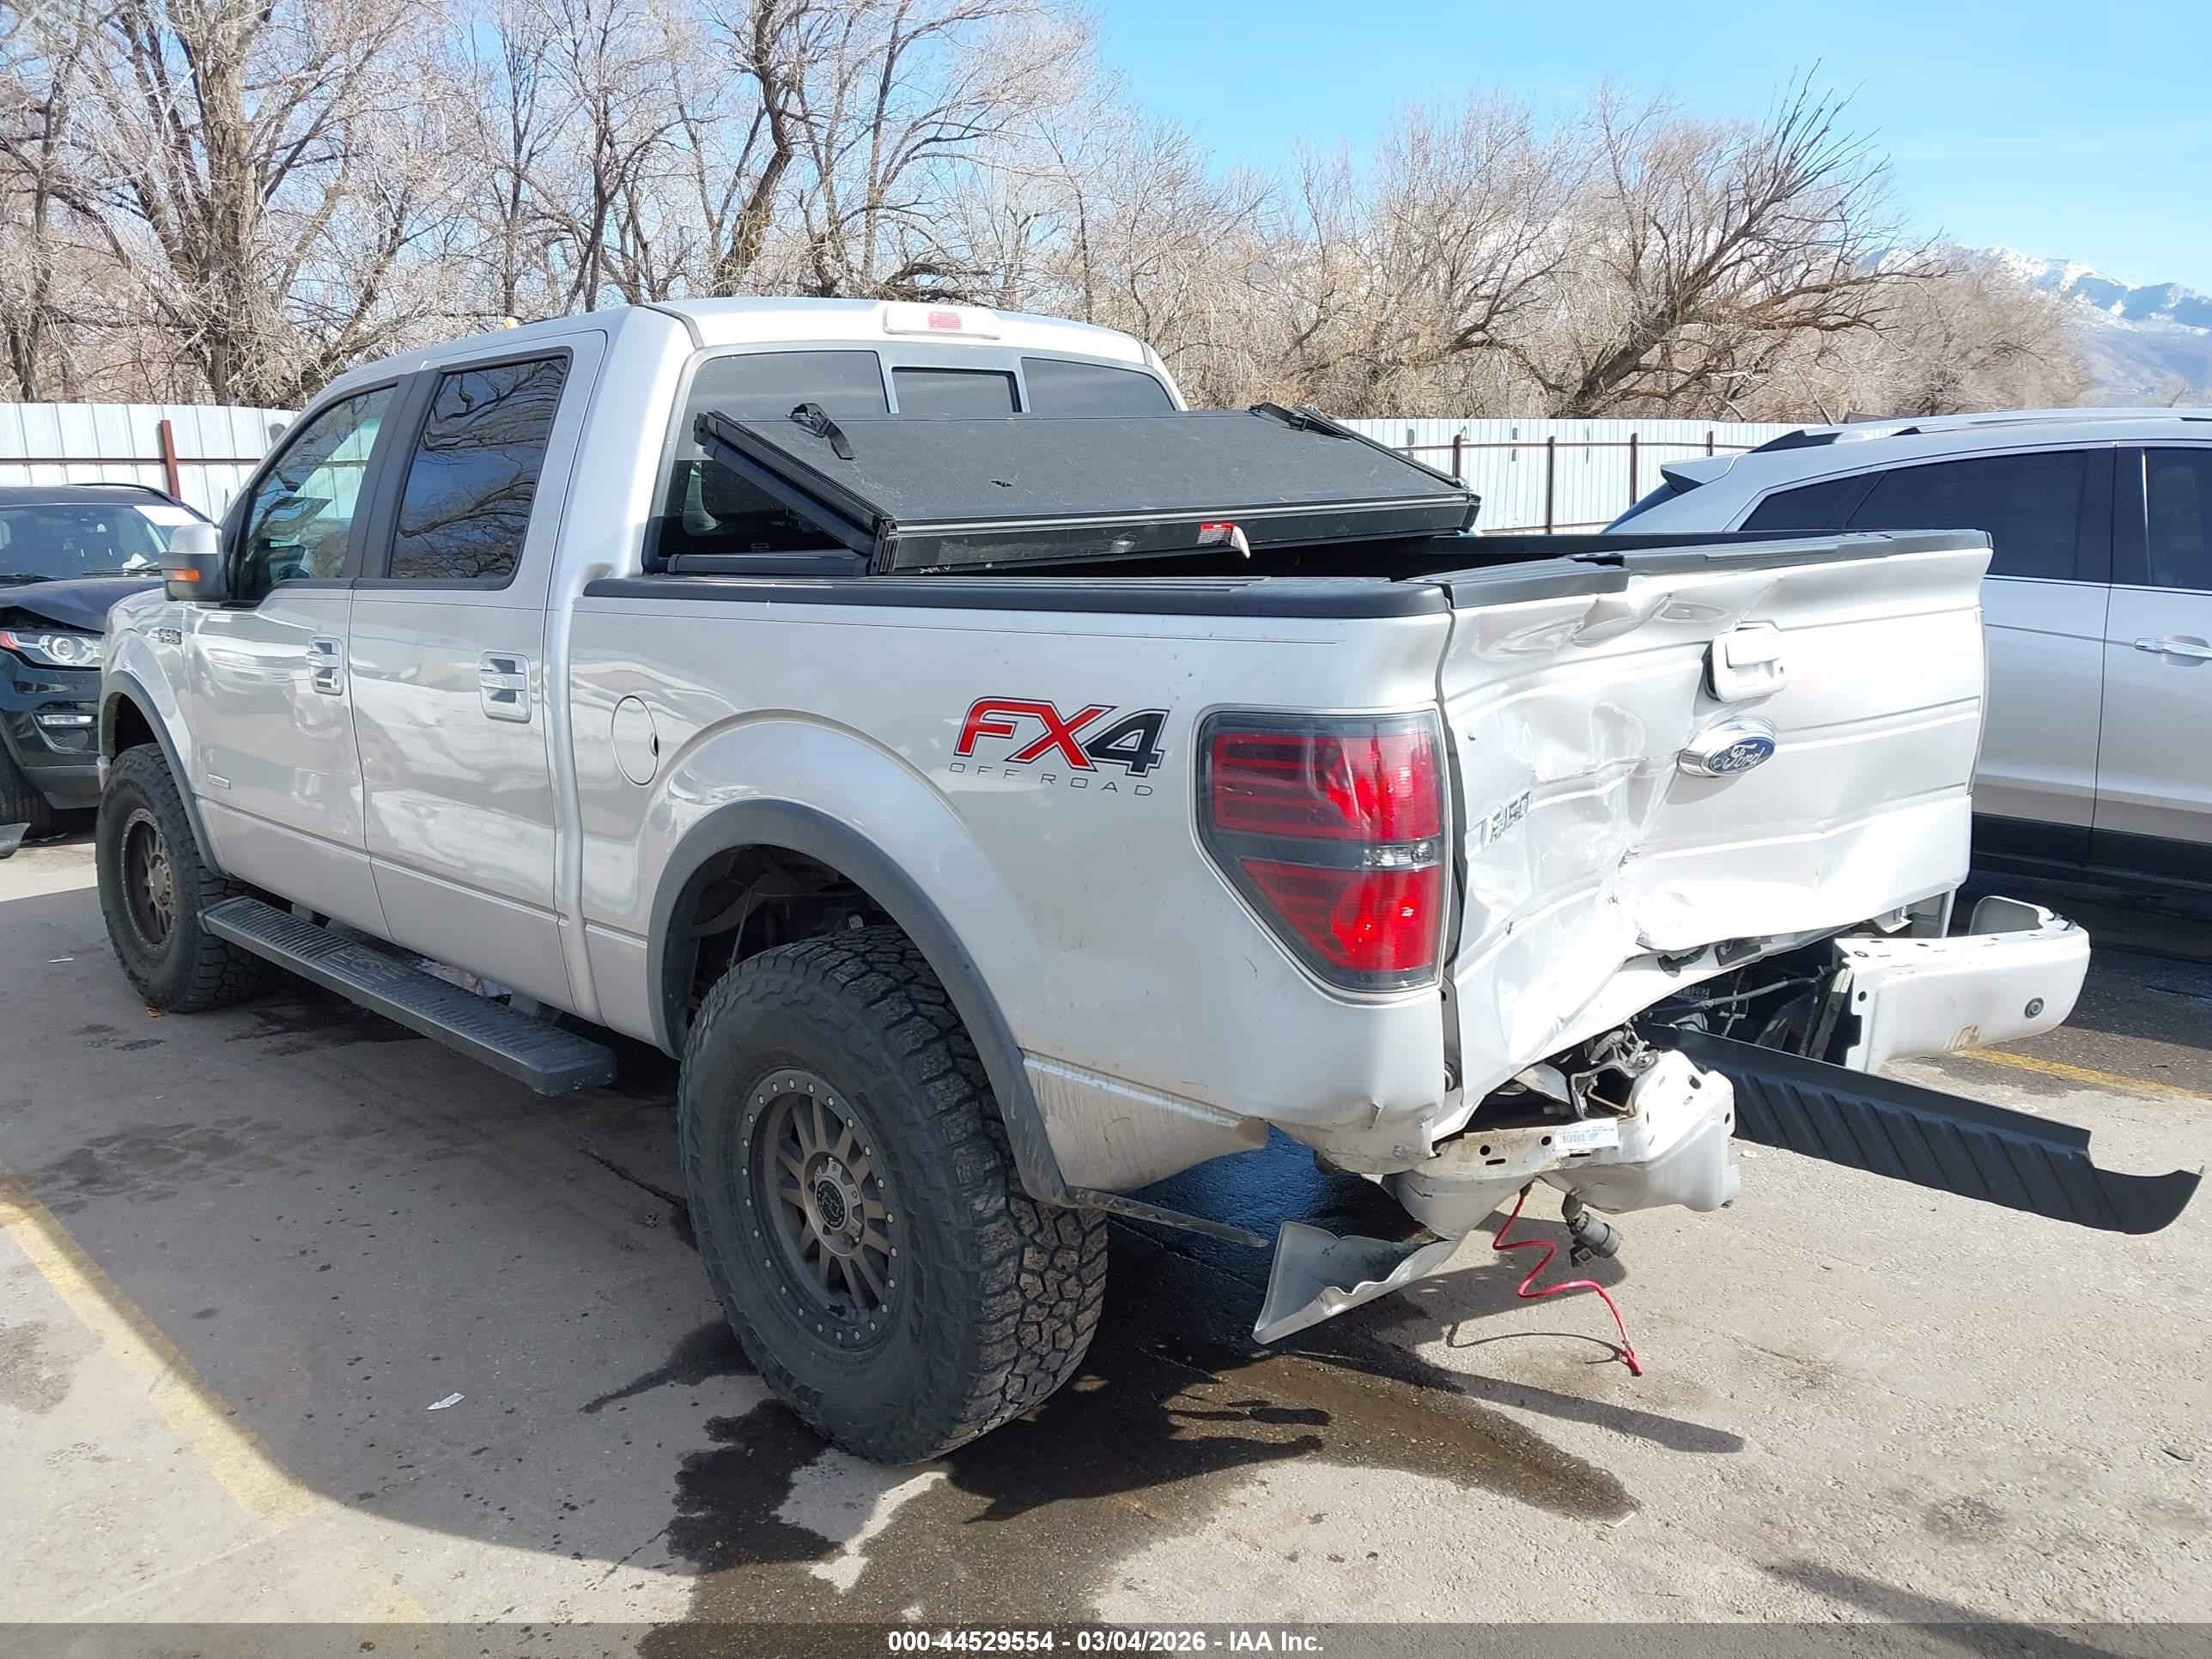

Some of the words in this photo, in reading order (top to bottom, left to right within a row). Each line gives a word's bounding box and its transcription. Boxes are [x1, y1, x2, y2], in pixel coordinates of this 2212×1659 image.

[953, 696, 1170, 777] FX4
[1713, 743, 1766, 770] Ford
[949, 763, 1021, 779] OFF
[1040, 774, 1153, 796] ROAD
